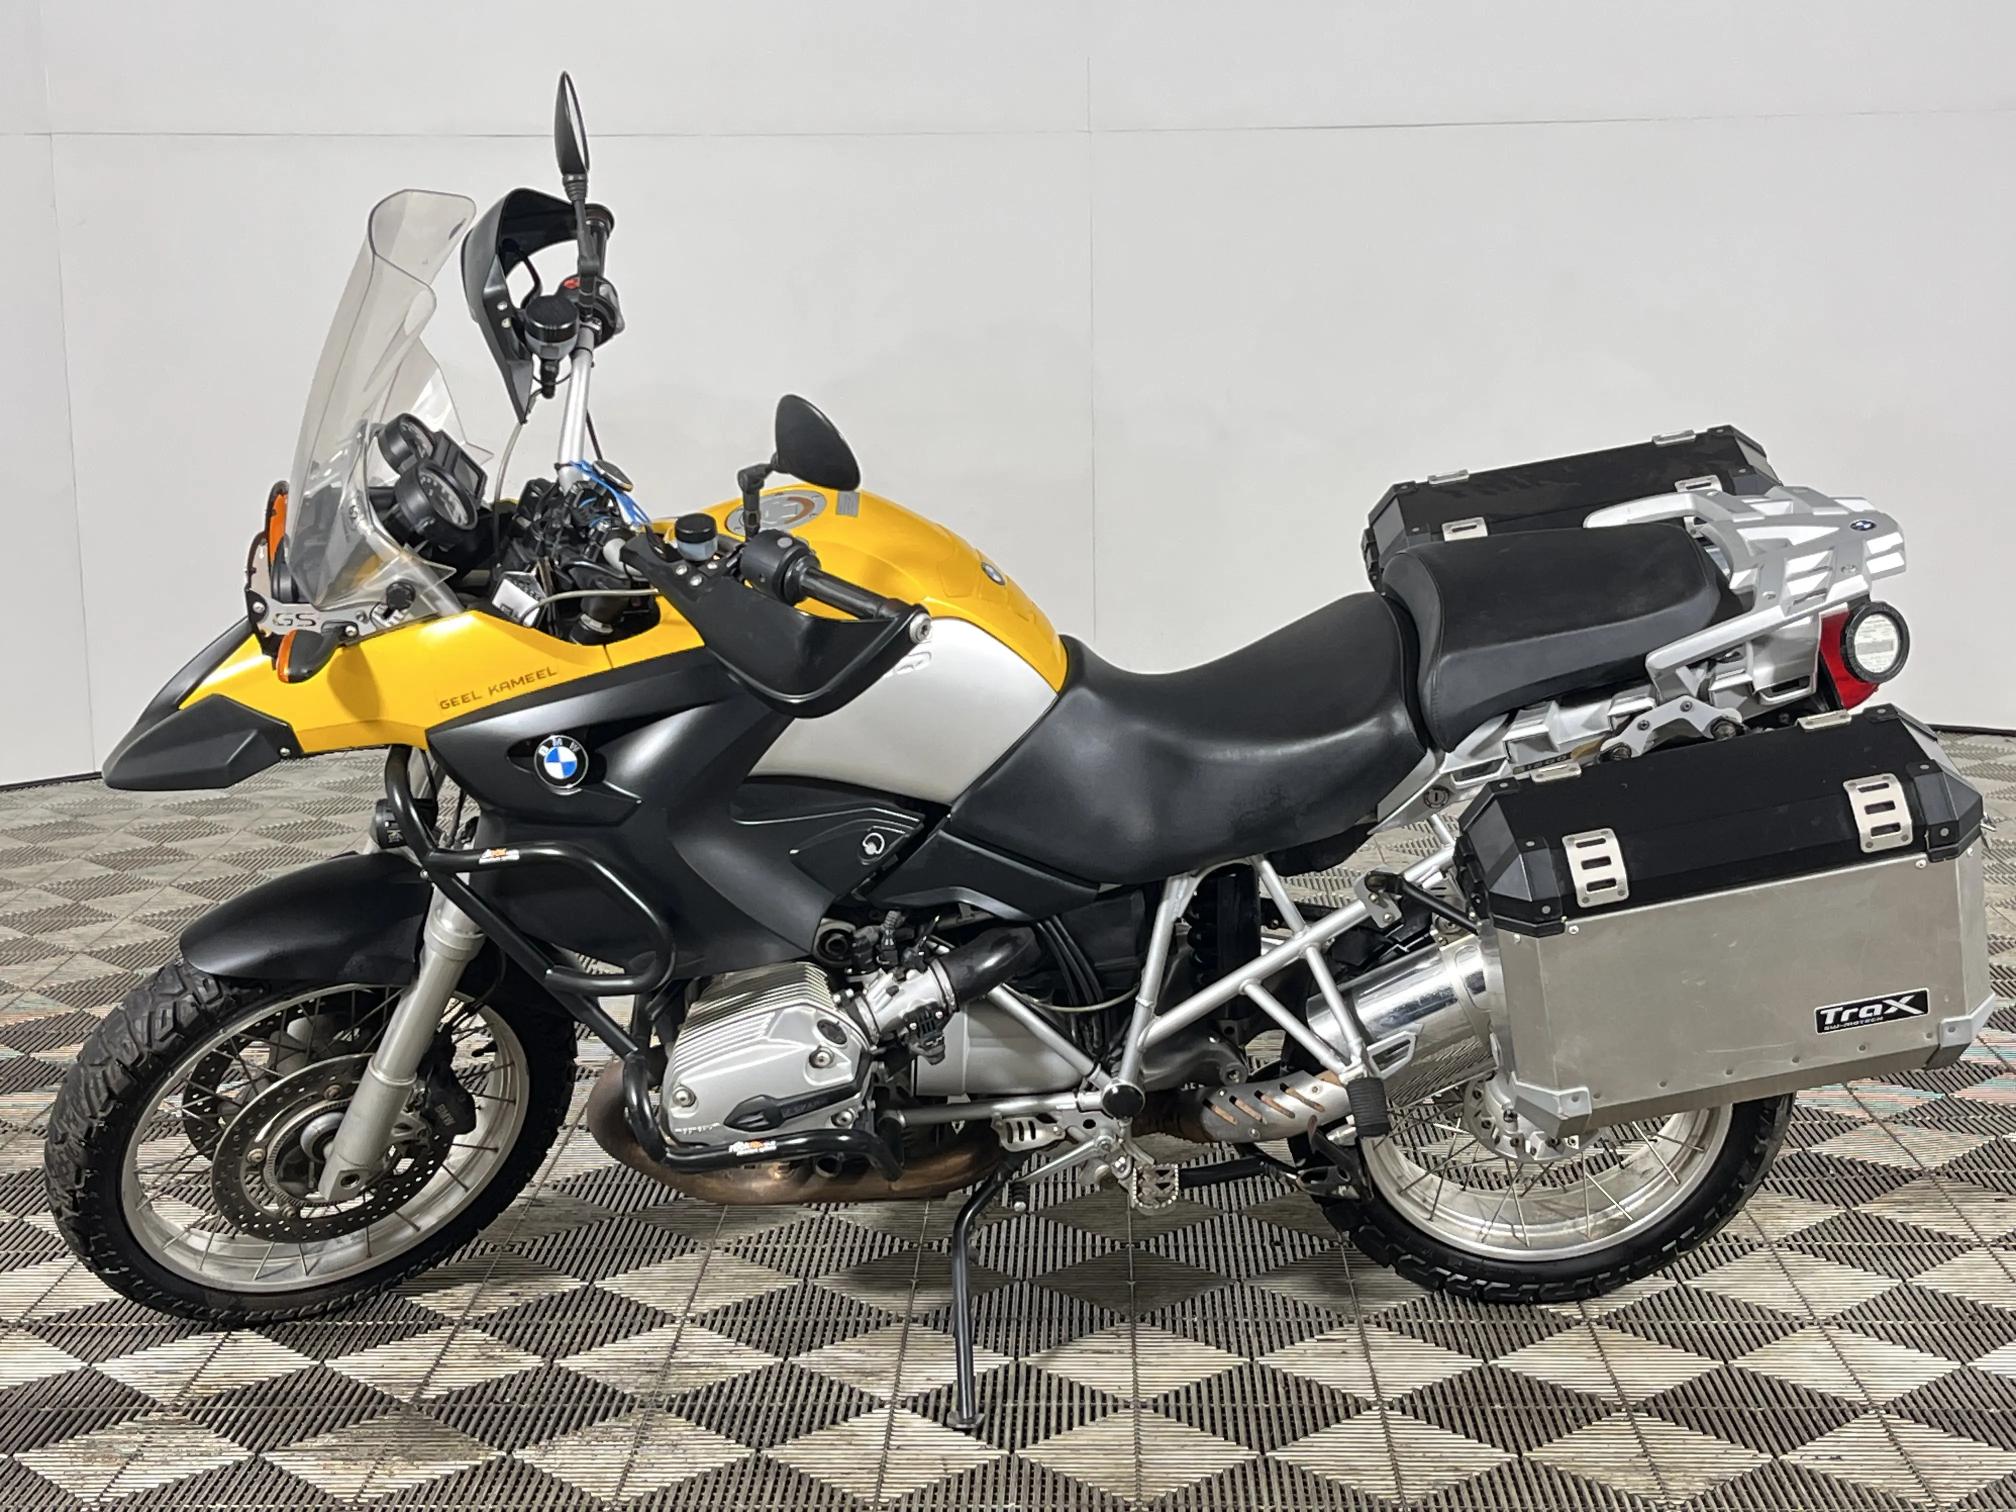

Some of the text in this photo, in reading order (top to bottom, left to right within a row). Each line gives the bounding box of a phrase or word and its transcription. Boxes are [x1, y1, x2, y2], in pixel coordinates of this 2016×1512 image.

[272, 612, 317, 627] GS
[439, 666, 558, 710] GEEL KAMEEL
[538, 737, 581, 757] BMW
